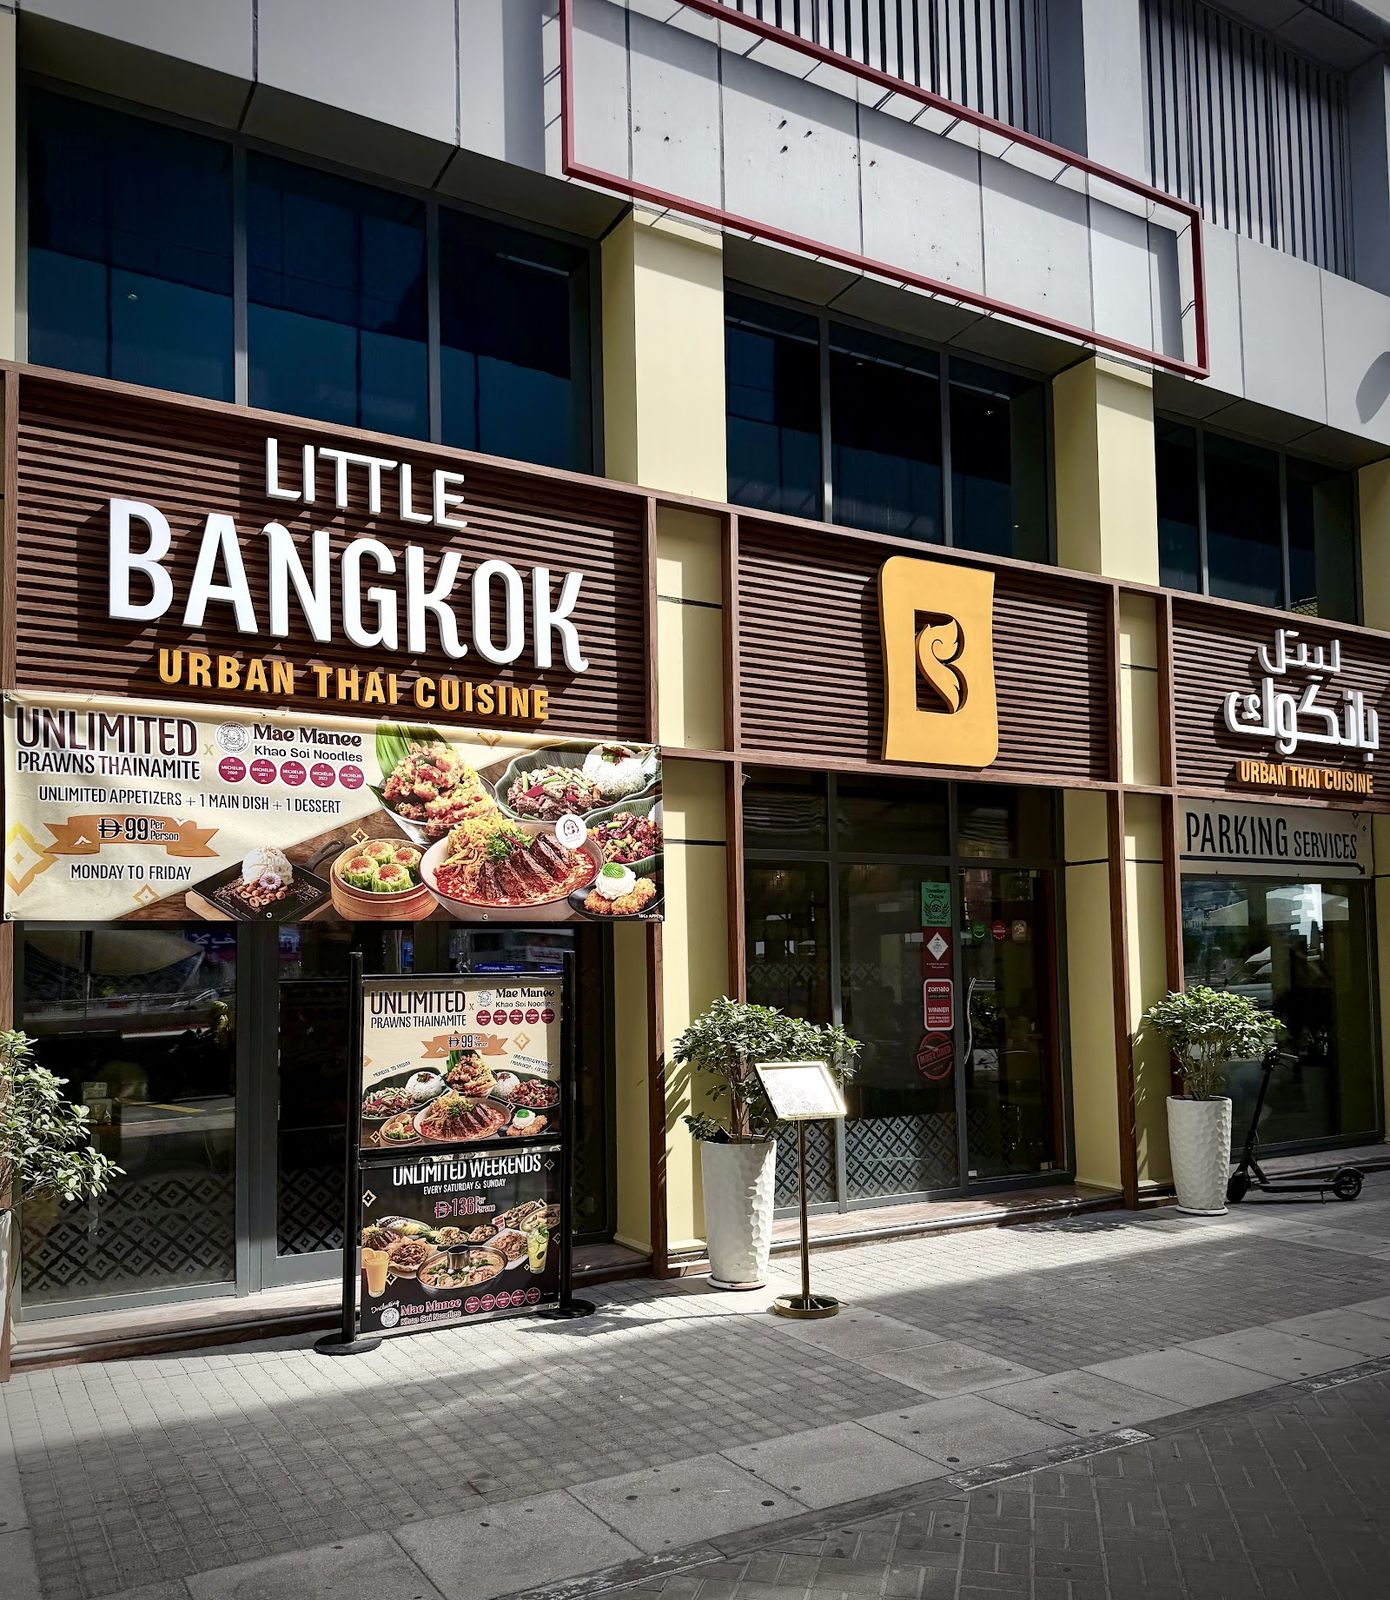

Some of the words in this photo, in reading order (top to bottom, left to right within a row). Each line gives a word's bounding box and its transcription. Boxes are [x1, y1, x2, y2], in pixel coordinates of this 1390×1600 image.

[266, 437, 468, 530] LITTLE
[108, 497, 590, 674] BANGKOK
[158, 648, 294, 695] URBAN
[311, 665, 398, 705] THAI
[414, 676, 549, 719] CUISINE
[16, 706, 198, 757] UNLIMITED
[253, 723, 295, 742] Mae
[299, 727, 362, 747] Manee
[254, 745, 287, 757] Khao
[290, 747, 310, 759] Soi
[313, 750, 363, 763] Noodles
[17, 751, 95, 774] PRAWNS
[98, 755, 200, 780] THAINAMITE
[1239, 760, 1287, 786] URBAN
[1289, 766, 1321, 789] THAI
[1323, 769, 1374, 794] CUISINE
[39, 786, 107, 803] UNLIMITED
[109, 789, 182, 806] APPETIZERS
[186, 797, 196, 806] +
[199, 793, 205, 807] 1
[209, 794, 239, 809] MAIN
[242, 795, 269, 810] DISH
[273, 801, 282, 810] +
[286, 798, 291, 811] 1
[294, 798, 341, 813] DESSERT
[125, 817, 148, 840] 99
[150, 819, 164, 830] Per
[1185, 811, 1289, 857] PARKING
[1293, 830, 1357, 859] SERVICES
[150, 831, 179, 841] Person
[71, 864, 125, 879] MONDAY
[128, 865, 144, 880] TO
[149, 866, 192, 880] FRIDAY
[370, 990, 466, 1015] UNLIMITED
[495, 987, 518, 999] Mae
[521, 987, 555, 998] Manee
[370, 1015, 411, 1029] PRAWNS
[413, 1014, 467, 1028] THAINAMITE
[461, 1034, 473, 1048] 99
[393, 1160, 467, 1187] UNLIMITED
[468, 1153, 542, 1179] WEEKENDS
[423, 1185, 443, 1196] EVERY
[443, 1181, 475, 1194] SATURDAY
[474, 1180, 482, 1190] &
[483, 1178, 507, 1190] SUNDAY
[452, 1196, 475, 1217] 136
[475, 1195, 486, 1205] Per
[475, 1204, 496, 1214] Person
[400, 1304, 424, 1317] Mae
[425, 1299, 462, 1313] Manee
[420, 1313, 432, 1323] Soi
